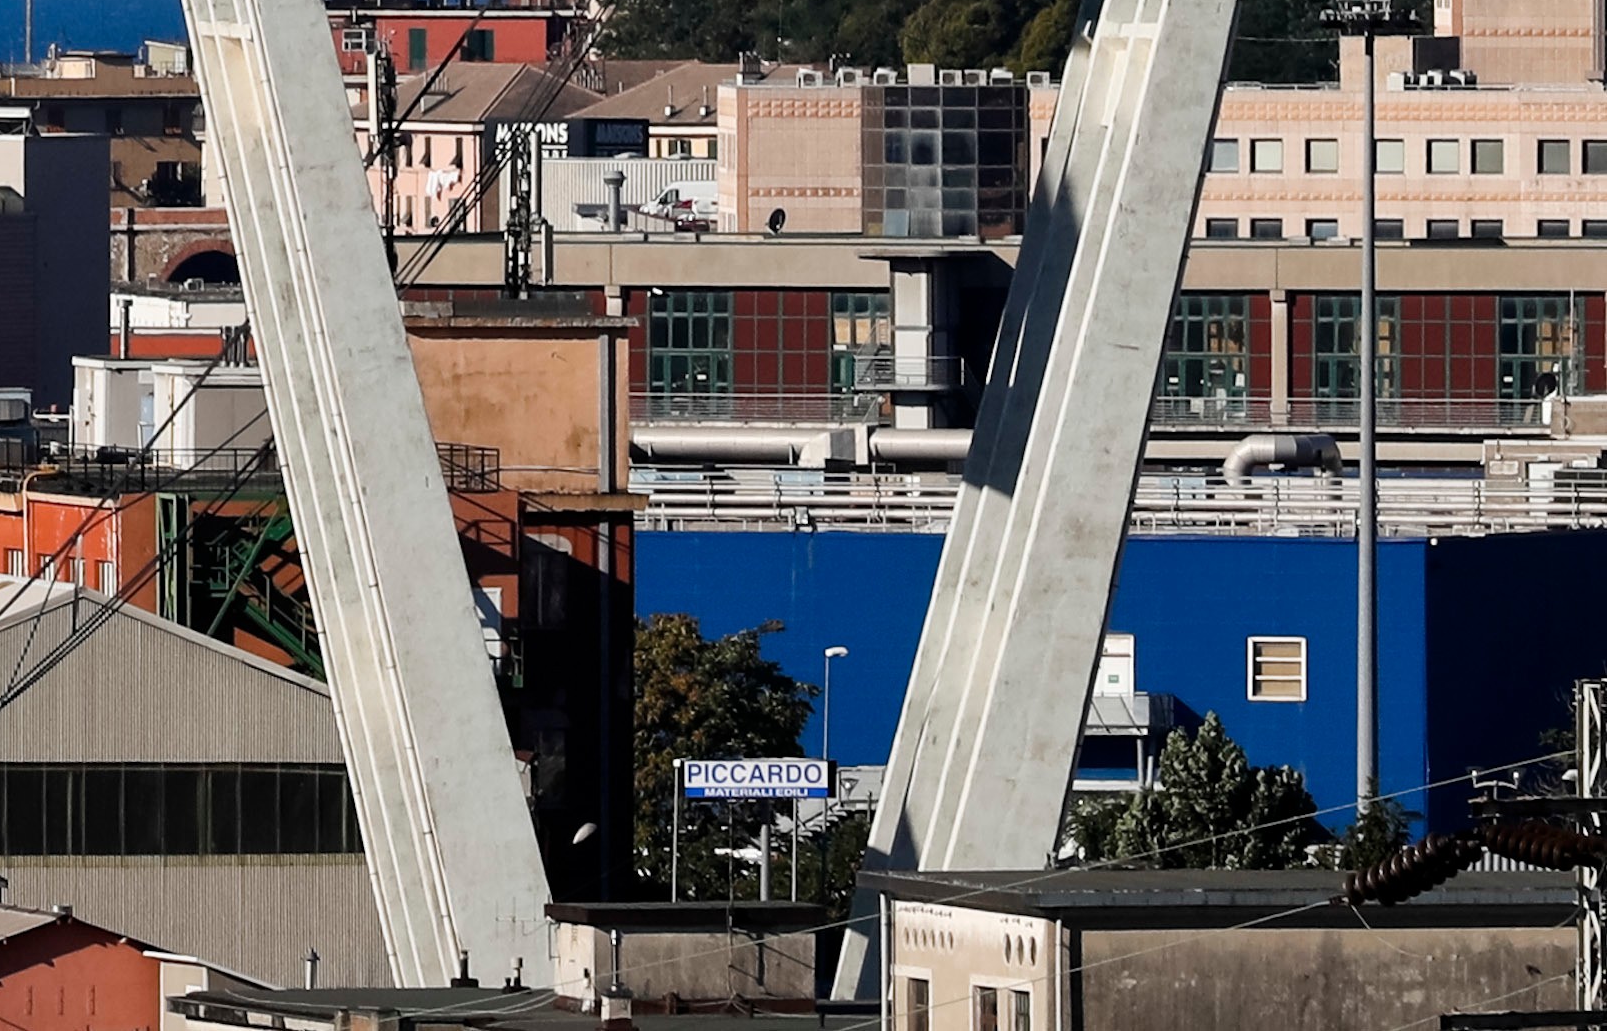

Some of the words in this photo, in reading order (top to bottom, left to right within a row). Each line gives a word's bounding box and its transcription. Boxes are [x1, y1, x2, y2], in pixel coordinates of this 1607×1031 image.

[687, 763, 823, 784] PICCARDO
[703, 788, 774, 798] MATERIALI
[775, 788, 809, 798] EDILI
